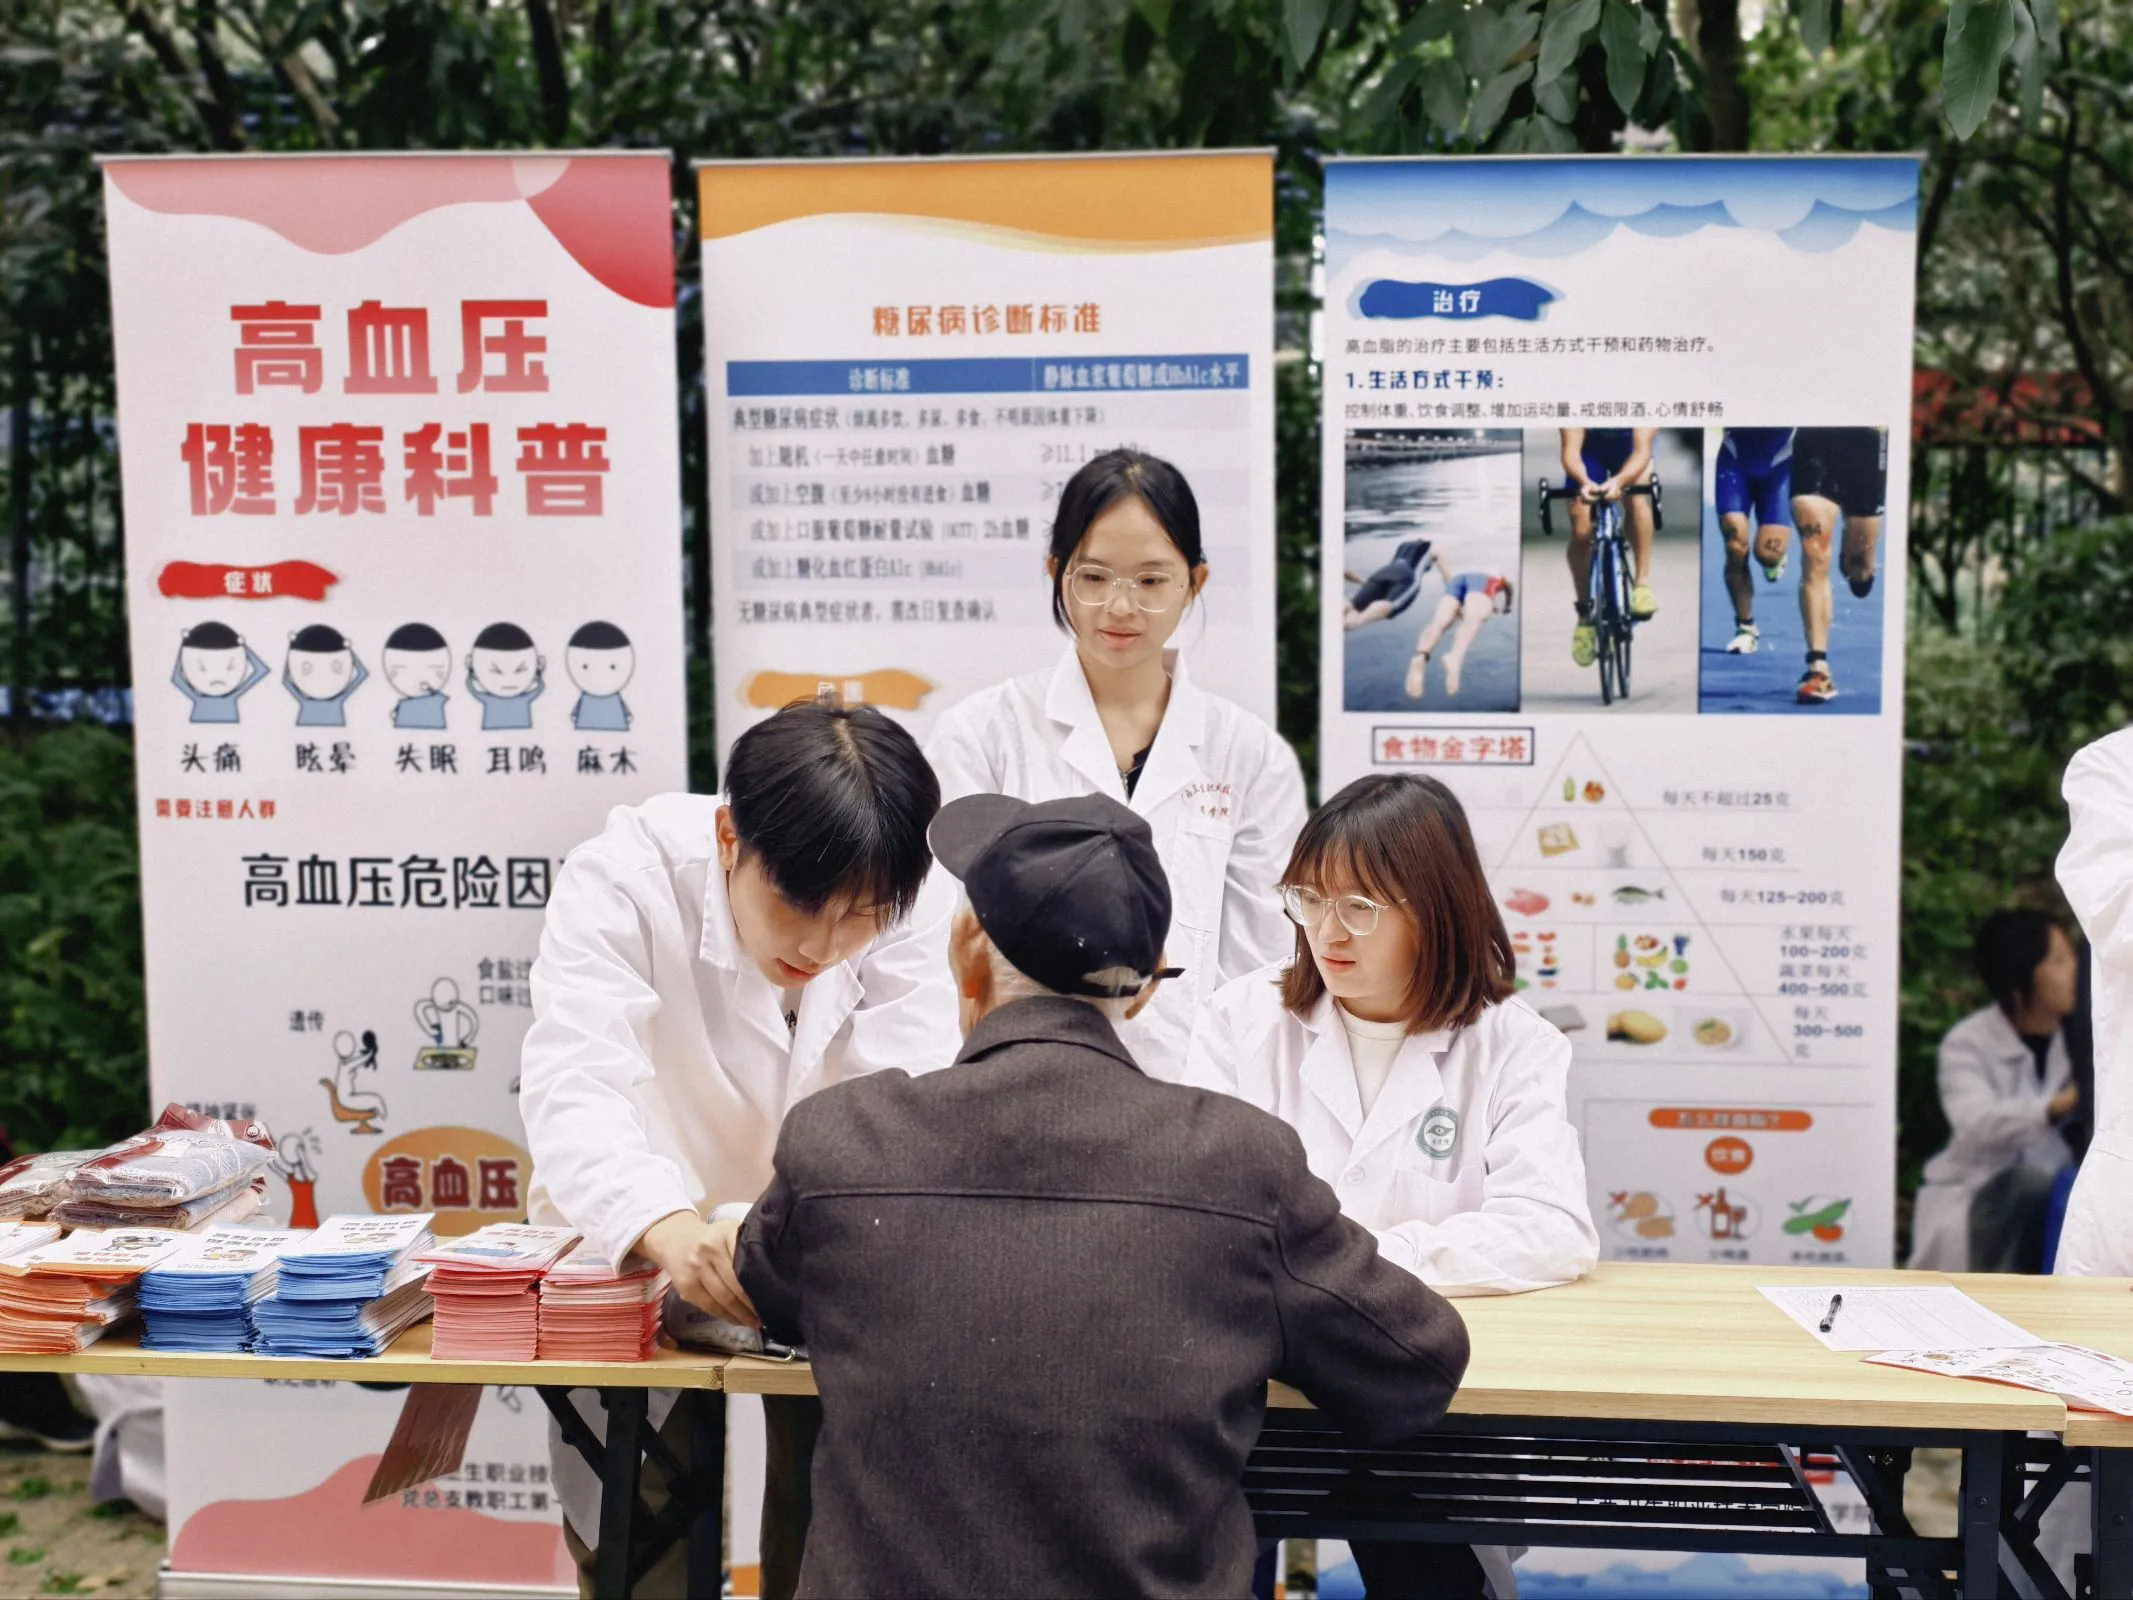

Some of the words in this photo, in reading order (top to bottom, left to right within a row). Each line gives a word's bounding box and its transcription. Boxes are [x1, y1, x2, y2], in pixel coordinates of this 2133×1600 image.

[1432, 290, 1481, 314] 治疗
[872, 303, 1102, 337] 糖尿病诊断标准
[230, 299, 549, 395] 高血压
[1345, 336, 1715, 355] 高血脂的治疗主要包括生活方式干预和药物治疗。
[849, 367, 911, 392] 诊断标准
[1345, 402, 1724, 420] 控制体重、饮食调整、增加运动量、戒烟限酒、心情舒畅
[181, 422, 611, 517] 健康科普
[224, 570, 273, 595] 症状
[181, 743, 242, 774] 头痛
[296, 744, 357, 774] 眩晕
[396, 745, 459, 775] 失眠
[487, 746, 547, 775] 耳鸣
[577, 746, 638, 775] 麻木
[1381, 735, 1526, 762] 食物金字塔
[241, 853, 566, 910] 高血压危险因
[380, 1156, 520, 1210] 高血压
